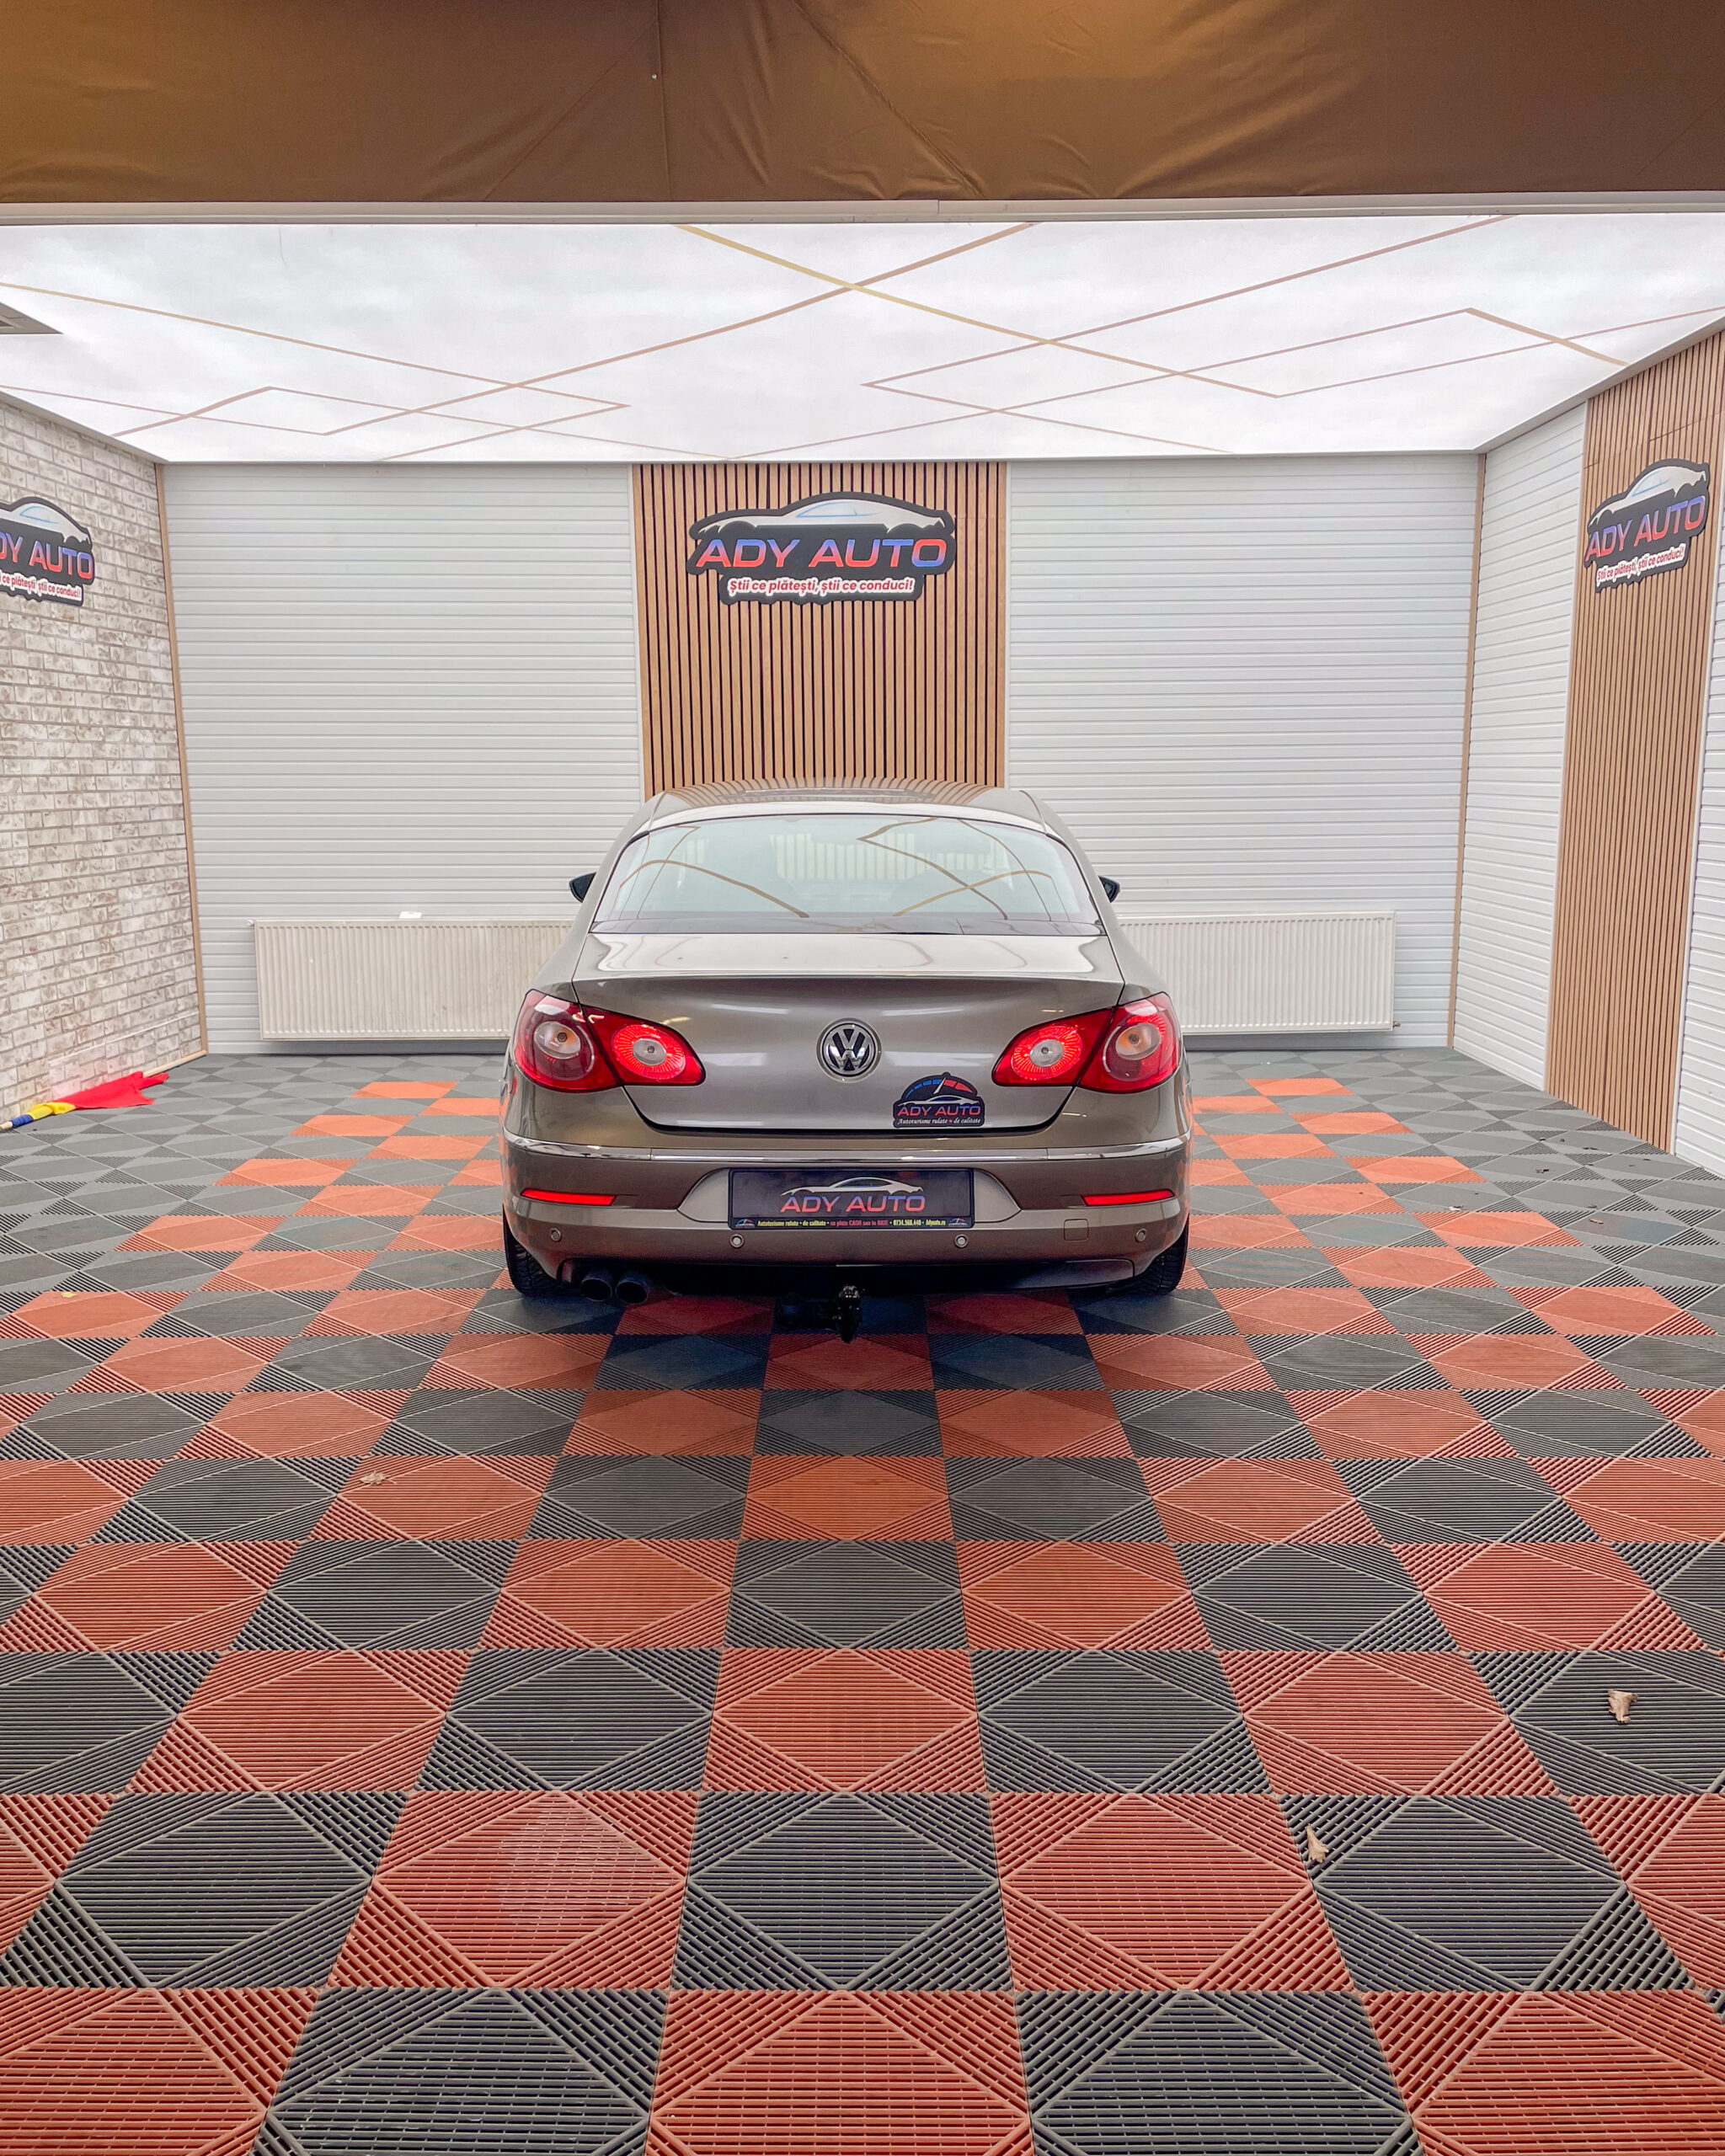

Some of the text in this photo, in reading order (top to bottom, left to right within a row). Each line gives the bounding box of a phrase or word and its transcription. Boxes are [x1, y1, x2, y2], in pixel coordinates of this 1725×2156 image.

[1585, 495, 1706, 562] ADY AUTO
[29, 540, 93, 579] AUTO
[696, 539, 947, 567] ADY AUTO
[752, 583, 766, 591] ce
[842, 583, 857, 591] ce
[860, 579, 913, 591] conduci!
[897, 1105, 981, 1116] ADY AUTO
[780, 1195, 926, 1213] ADY AUTO
